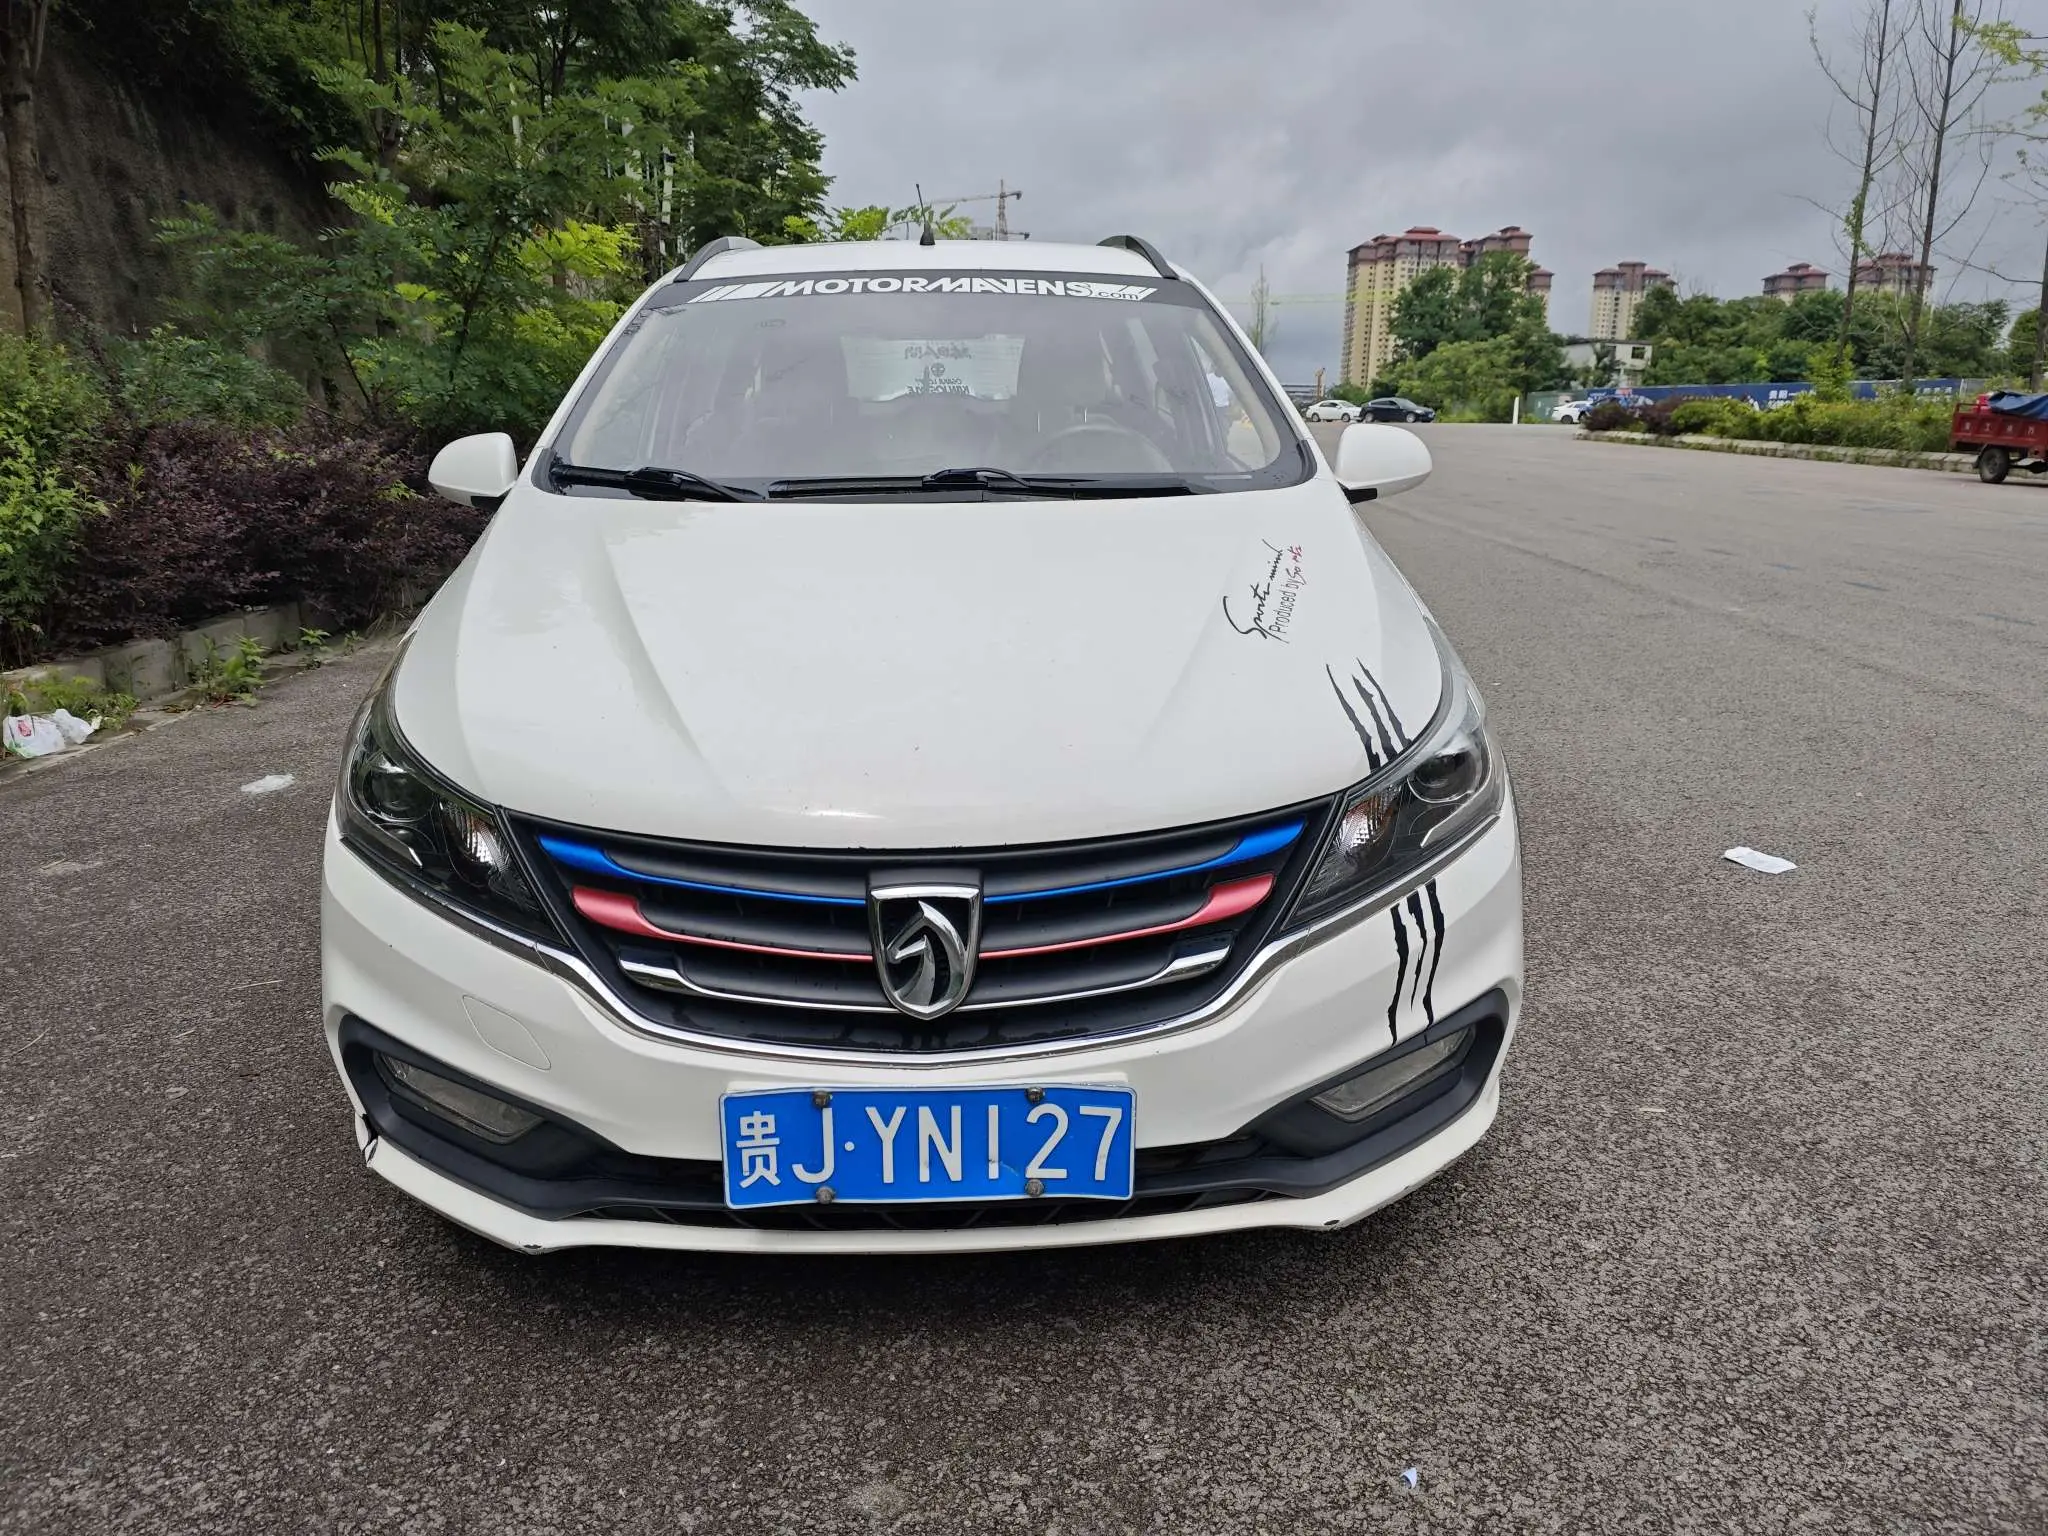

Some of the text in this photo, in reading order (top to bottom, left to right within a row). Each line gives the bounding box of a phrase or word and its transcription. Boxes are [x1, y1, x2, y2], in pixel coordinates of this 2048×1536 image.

[1223, 539, 1290, 644] Sports mind
[1268, 588, 1298, 634] Produced
